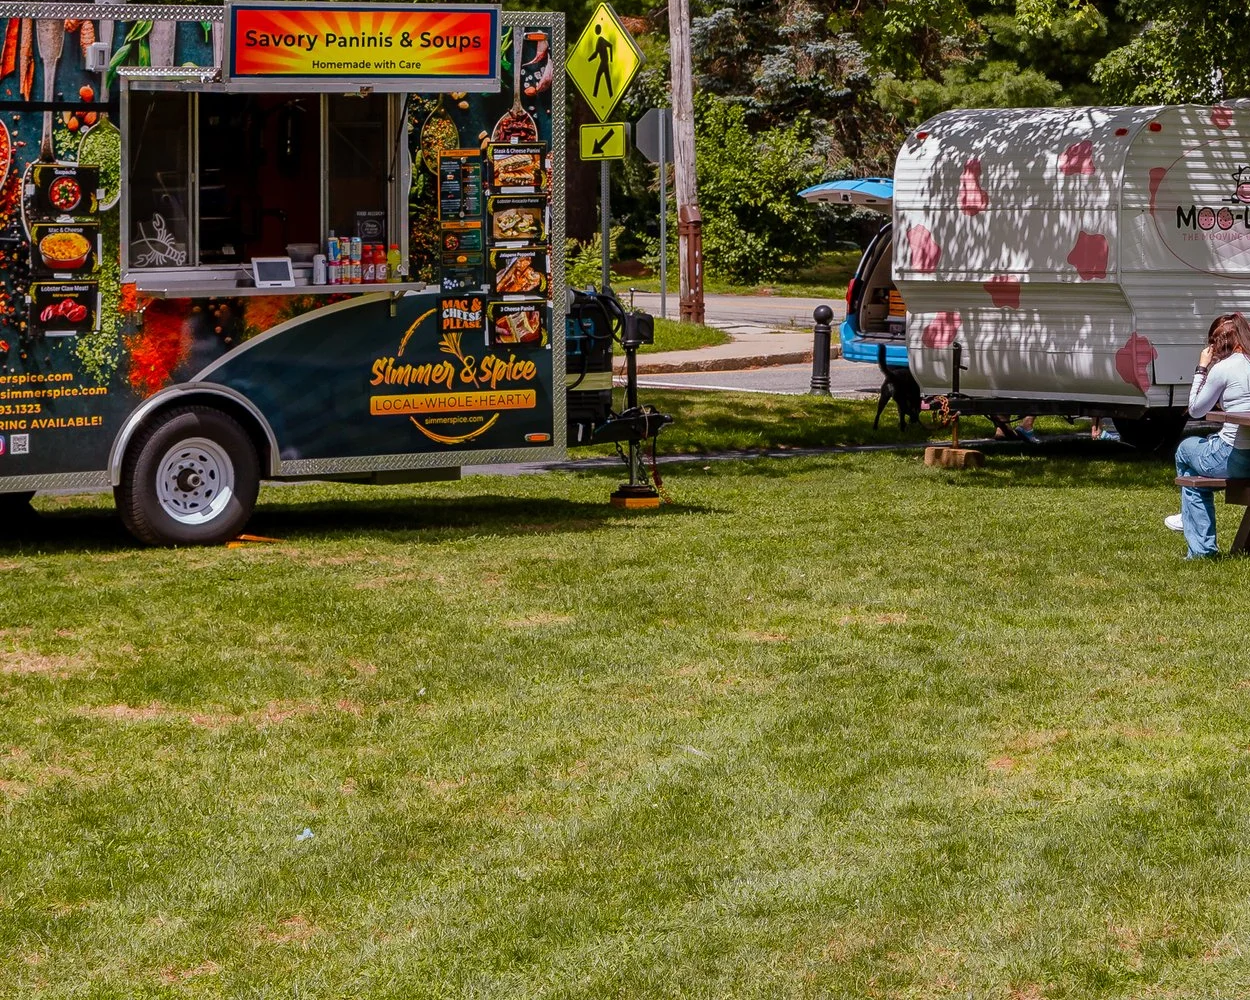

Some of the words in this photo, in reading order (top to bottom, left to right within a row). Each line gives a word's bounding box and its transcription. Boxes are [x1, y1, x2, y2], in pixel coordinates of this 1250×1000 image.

[245, 30, 318, 51] Savory
[325, 31, 393, 48] Paninis
[400, 31, 413, 48] &
[420, 31, 481, 52] Soups
[312, 60, 371, 69] Homemade
[374, 60, 396, 69] with
[399, 60, 421, 69] Care
[1182, 233, 1199, 241] THE
[442, 300, 469, 312] MAC
[471, 298, 482, 312] &
[442, 308, 482, 321] CHEESE
[442, 318, 482, 329] PLEASE
[0, 372, 73, 385] erspice.com
[370, 357, 455, 390] Simmer
[460, 355, 480, 389] &
[479, 354, 537, 390] Spice
[0, 386, 108, 399] simmerspice.com
[31, 416, 102, 429] AVAILABLE!
[425, 415, 484, 425] simmerspice.com
